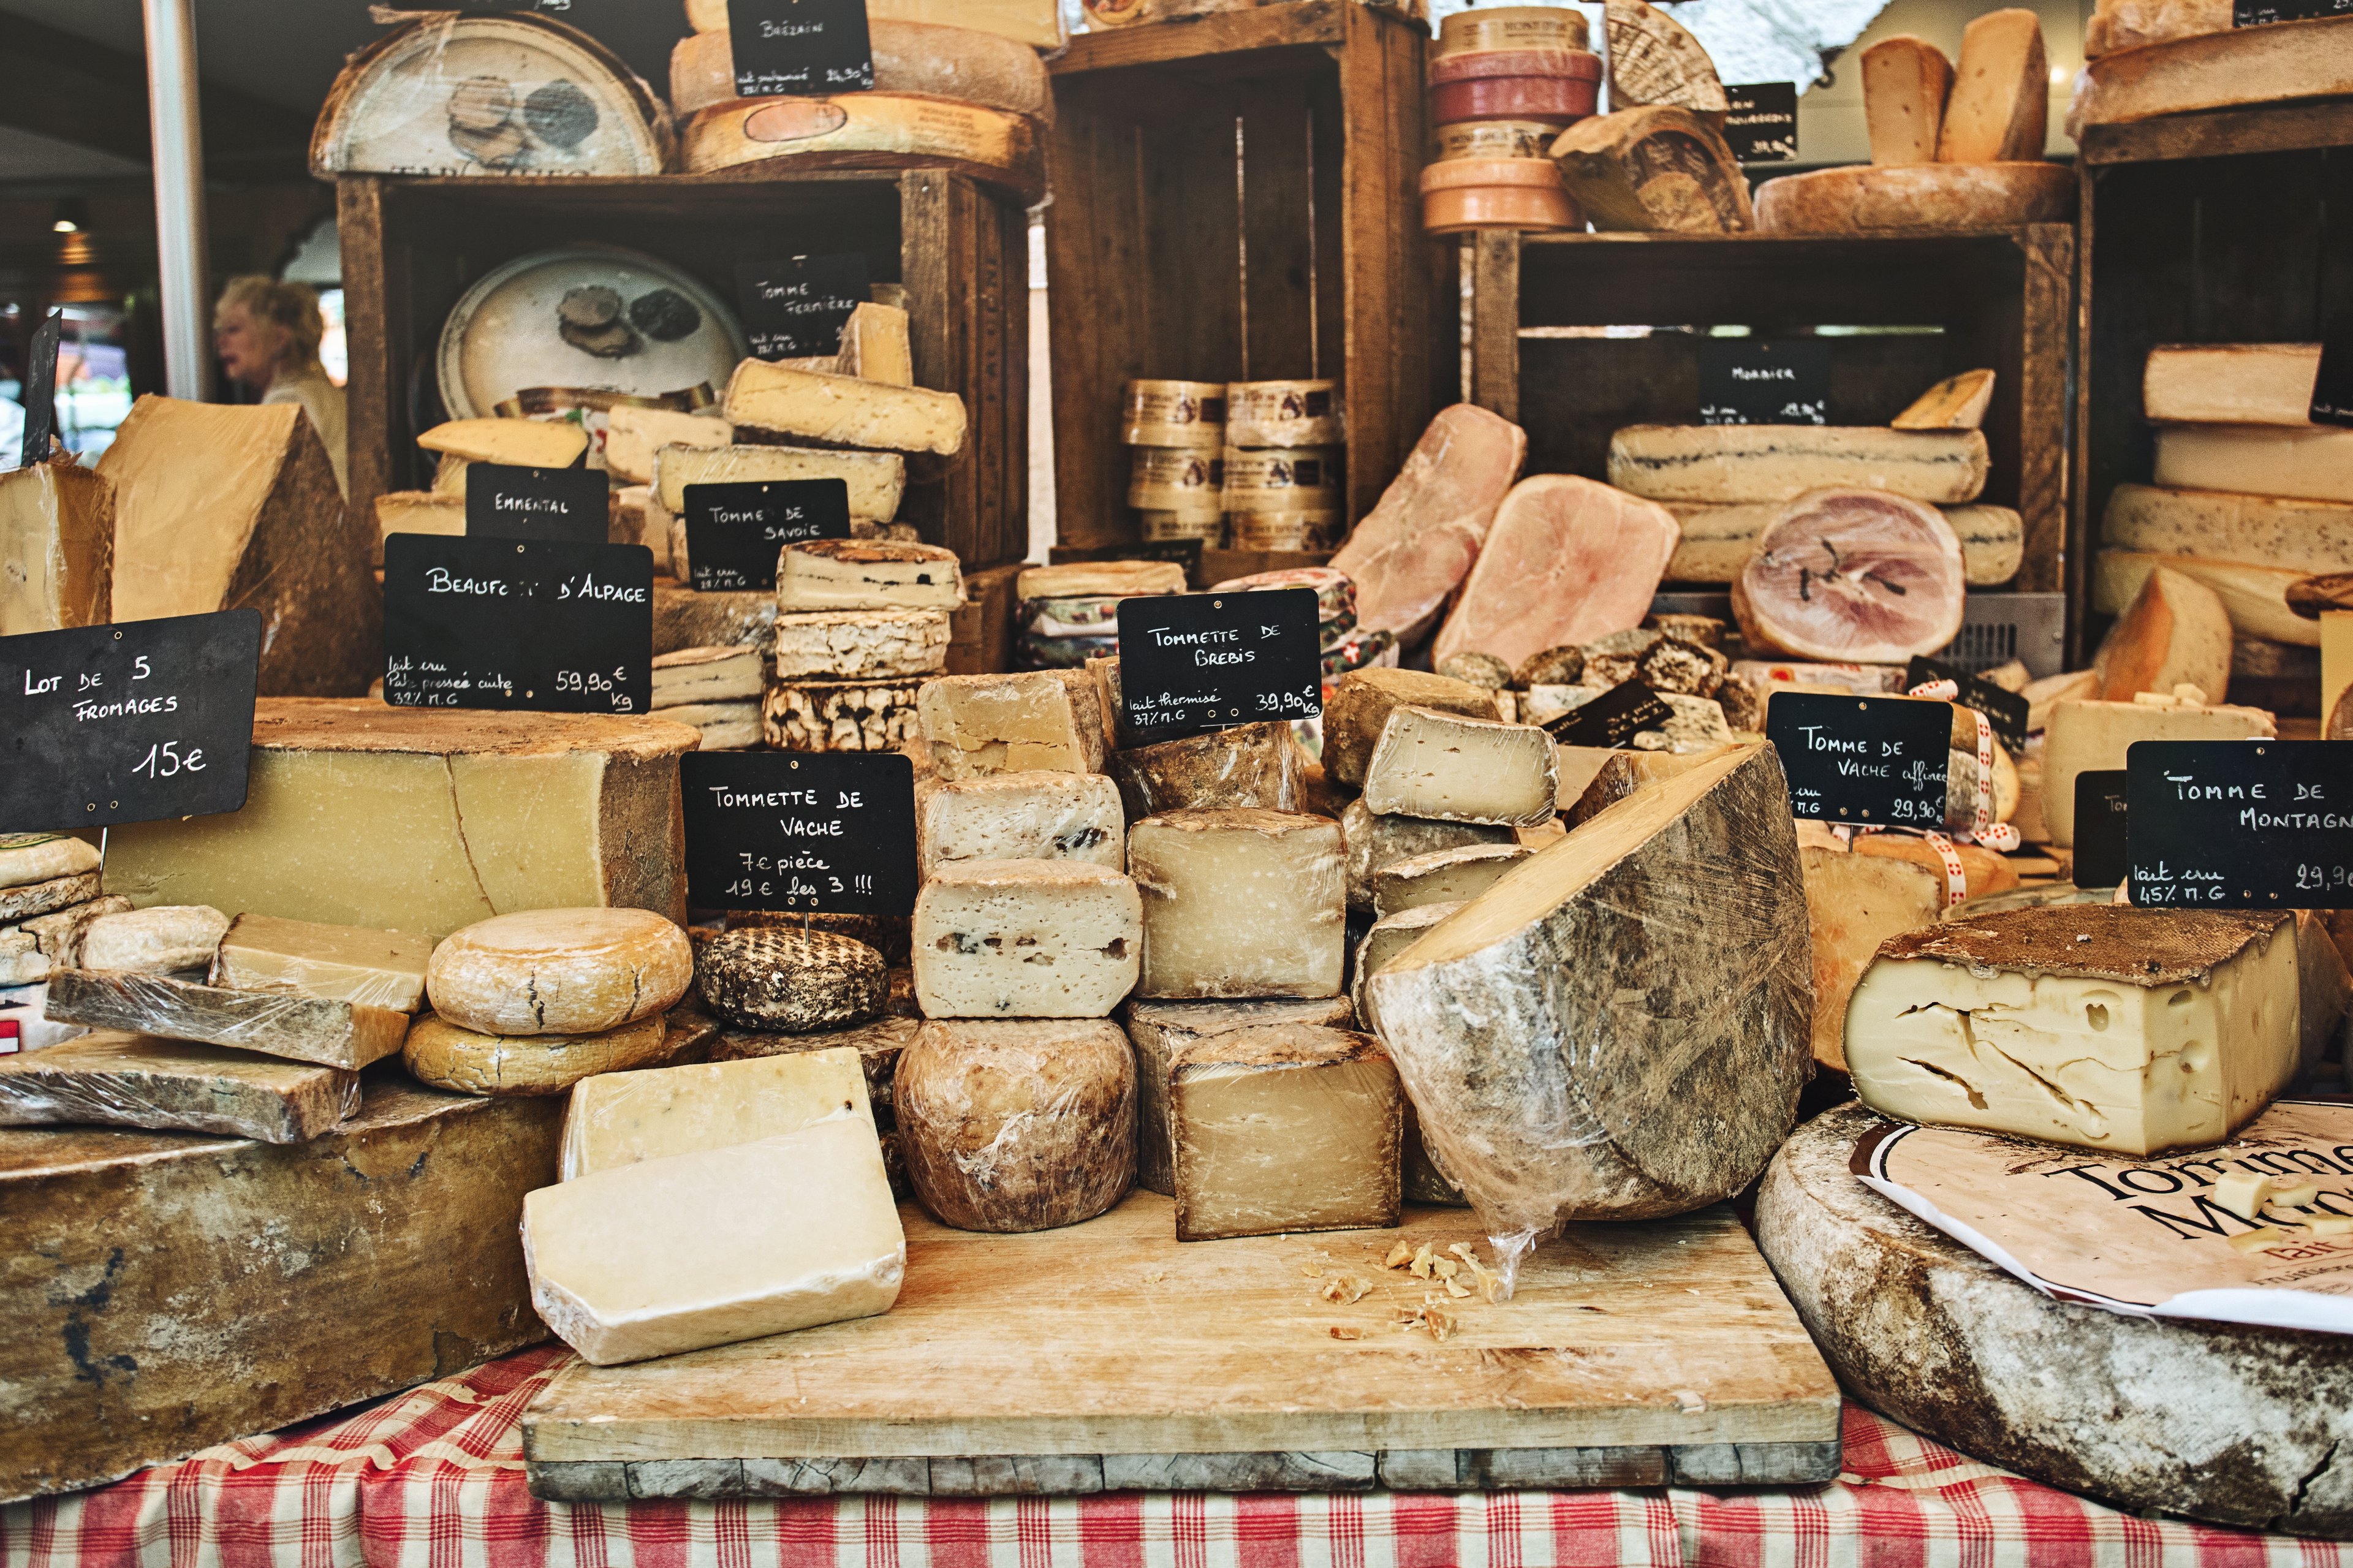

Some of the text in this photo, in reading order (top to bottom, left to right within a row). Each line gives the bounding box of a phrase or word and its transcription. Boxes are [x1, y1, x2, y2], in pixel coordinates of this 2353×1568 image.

[495, 492, 569, 513] EMMENTAL
[709, 506, 804, 523] TOMME DE
[764, 523, 820, 540] SAVOIE
[558, 573, 646, 602] D'ALPAGE
[1147, 624, 1281, 647] TOMMETTE DE
[389, 656, 447, 672] lait cru
[1195, 648, 1256, 667] BREBIS
[25, 656, 151, 695] LOT DE 5
[72, 696, 178, 722] FROMAGES
[1129, 695, 1156, 711] lait
[1158, 688, 1222, 706] thermisé
[1134, 712, 1158, 725] 37%
[1798, 725, 1904, 757] TOMME DE
[1838, 759, 1947, 791] VACHE affinée
[709, 786, 863, 809] TOMMETTE DE
[1795, 787, 1822, 797] cru
[2167, 775, 2325, 801] TOMME DE
[780, 817, 844, 836] VACHE
[2241, 807, 2353, 831] MONTAGN
[2134, 861, 2173, 881] lait
[2180, 869, 2225, 881] cru
[786, 876, 816, 896] les
[828, 876, 844, 893] 3
[855, 874, 872, 895] !!!
[2140, 884, 2176, 904] 45%
